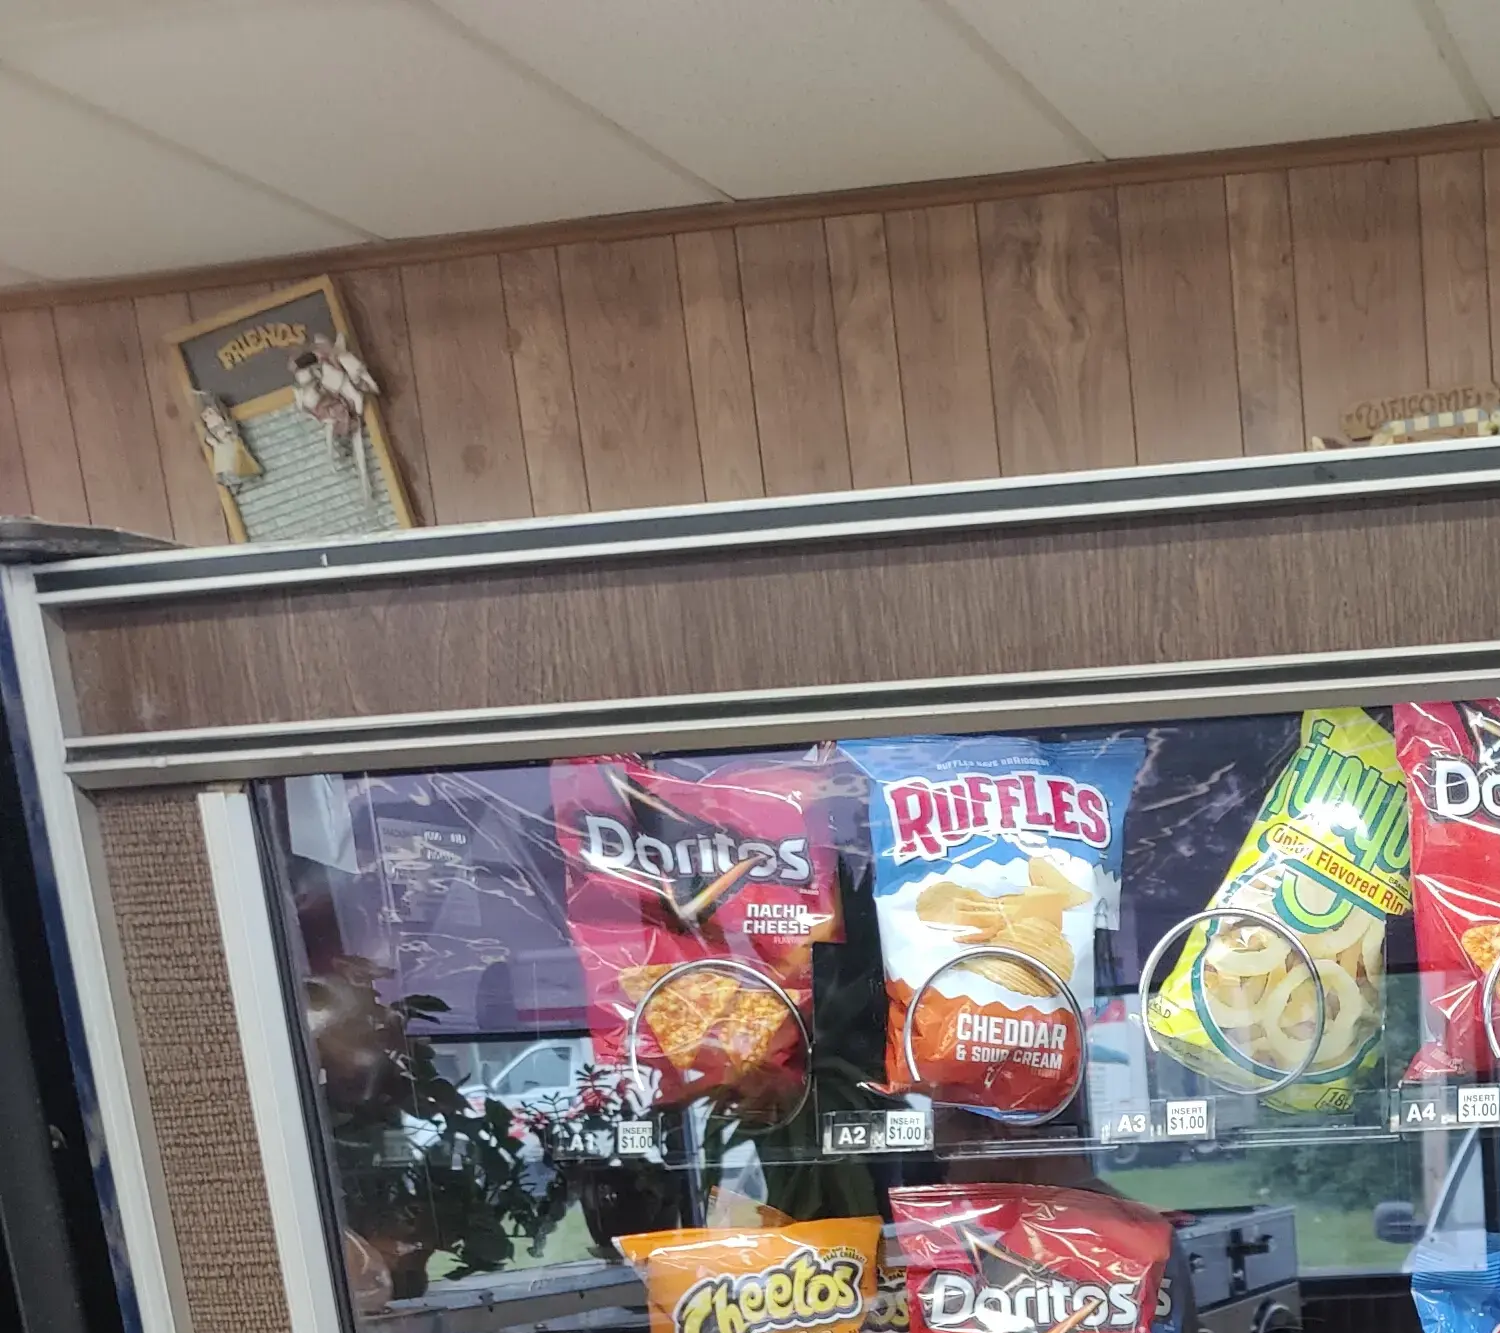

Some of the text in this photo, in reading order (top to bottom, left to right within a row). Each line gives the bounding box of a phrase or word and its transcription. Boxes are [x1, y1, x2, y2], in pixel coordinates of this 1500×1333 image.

[886, 773, 1110, 858] RUFFLES
[584, 815, 813, 881] Doritos
[1315, 850, 1381, 901] Flavored
[747, 903, 808, 919] NACHO
[742, 919, 810, 935] CHEESE
[957, 1012, 1067, 1050] CHEDDAR
[972, 1046, 1063, 1070] SOUR CREAM
[1463, 1094, 1496, 1103] INSERT
[1171, 1106, 1203, 1115] INSERT
[1406, 1102, 1436, 1122] A4
[1462, 1103, 1497, 1117] $1.00
[1117, 1113, 1146, 1132] A3
[1170, 1115, 1204, 1130] $1.00
[621, 1135, 653, 1149] $1.00
[837, 1125, 867, 1146] A2
[888, 1126, 921, 1141] $1.00
[932, 1273, 1138, 1329] Doritos
